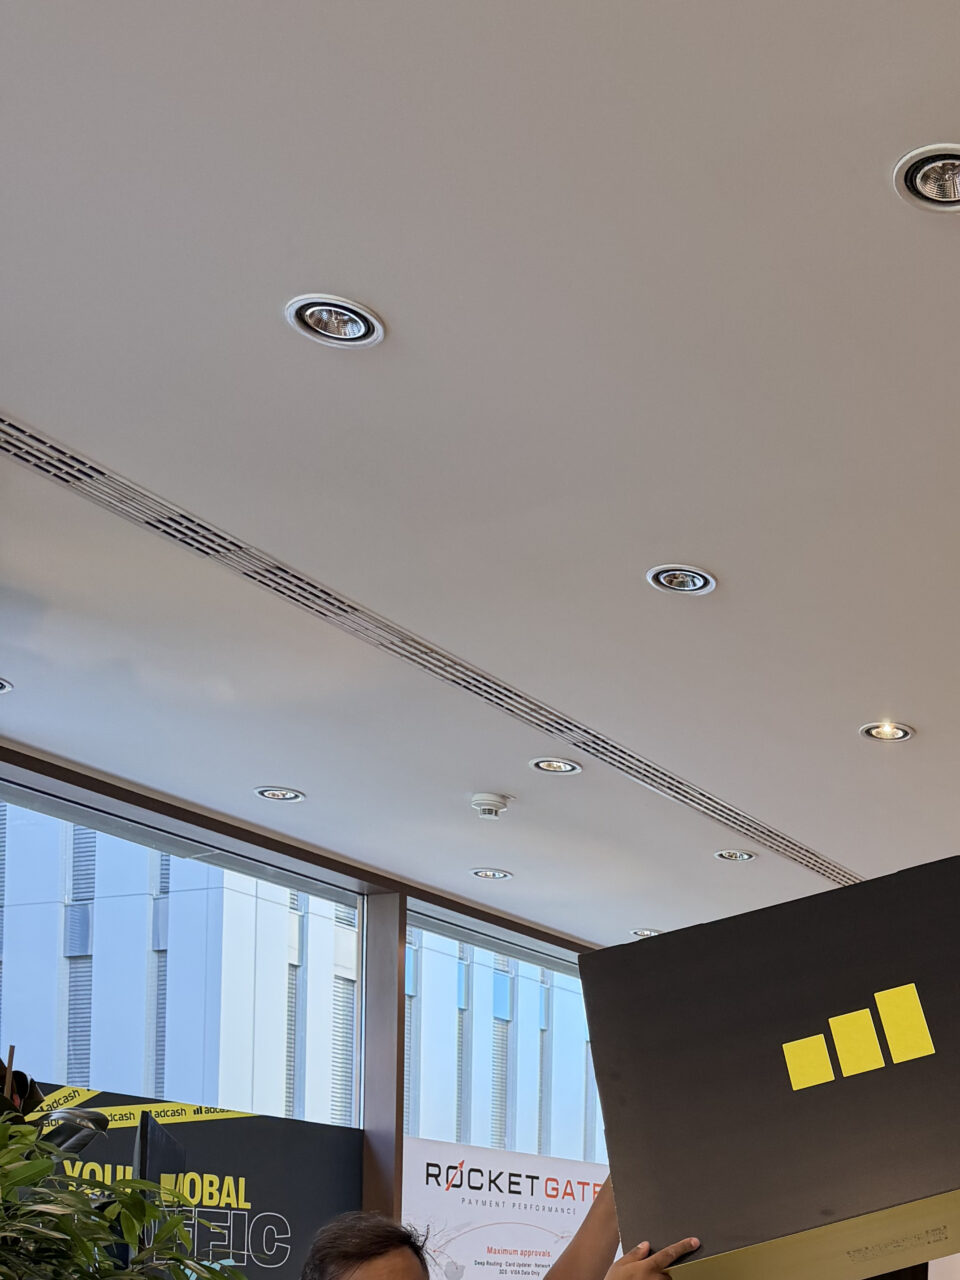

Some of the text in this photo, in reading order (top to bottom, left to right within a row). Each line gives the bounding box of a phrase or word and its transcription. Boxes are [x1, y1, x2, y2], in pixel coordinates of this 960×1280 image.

[46, 1089, 81, 1111] adcash
[154, 1107, 187, 1119] adcash
[461, 1197, 577, 1215] PAYMENT PERFORMANCE
[486, 1246, 519, 1256] Maximum
